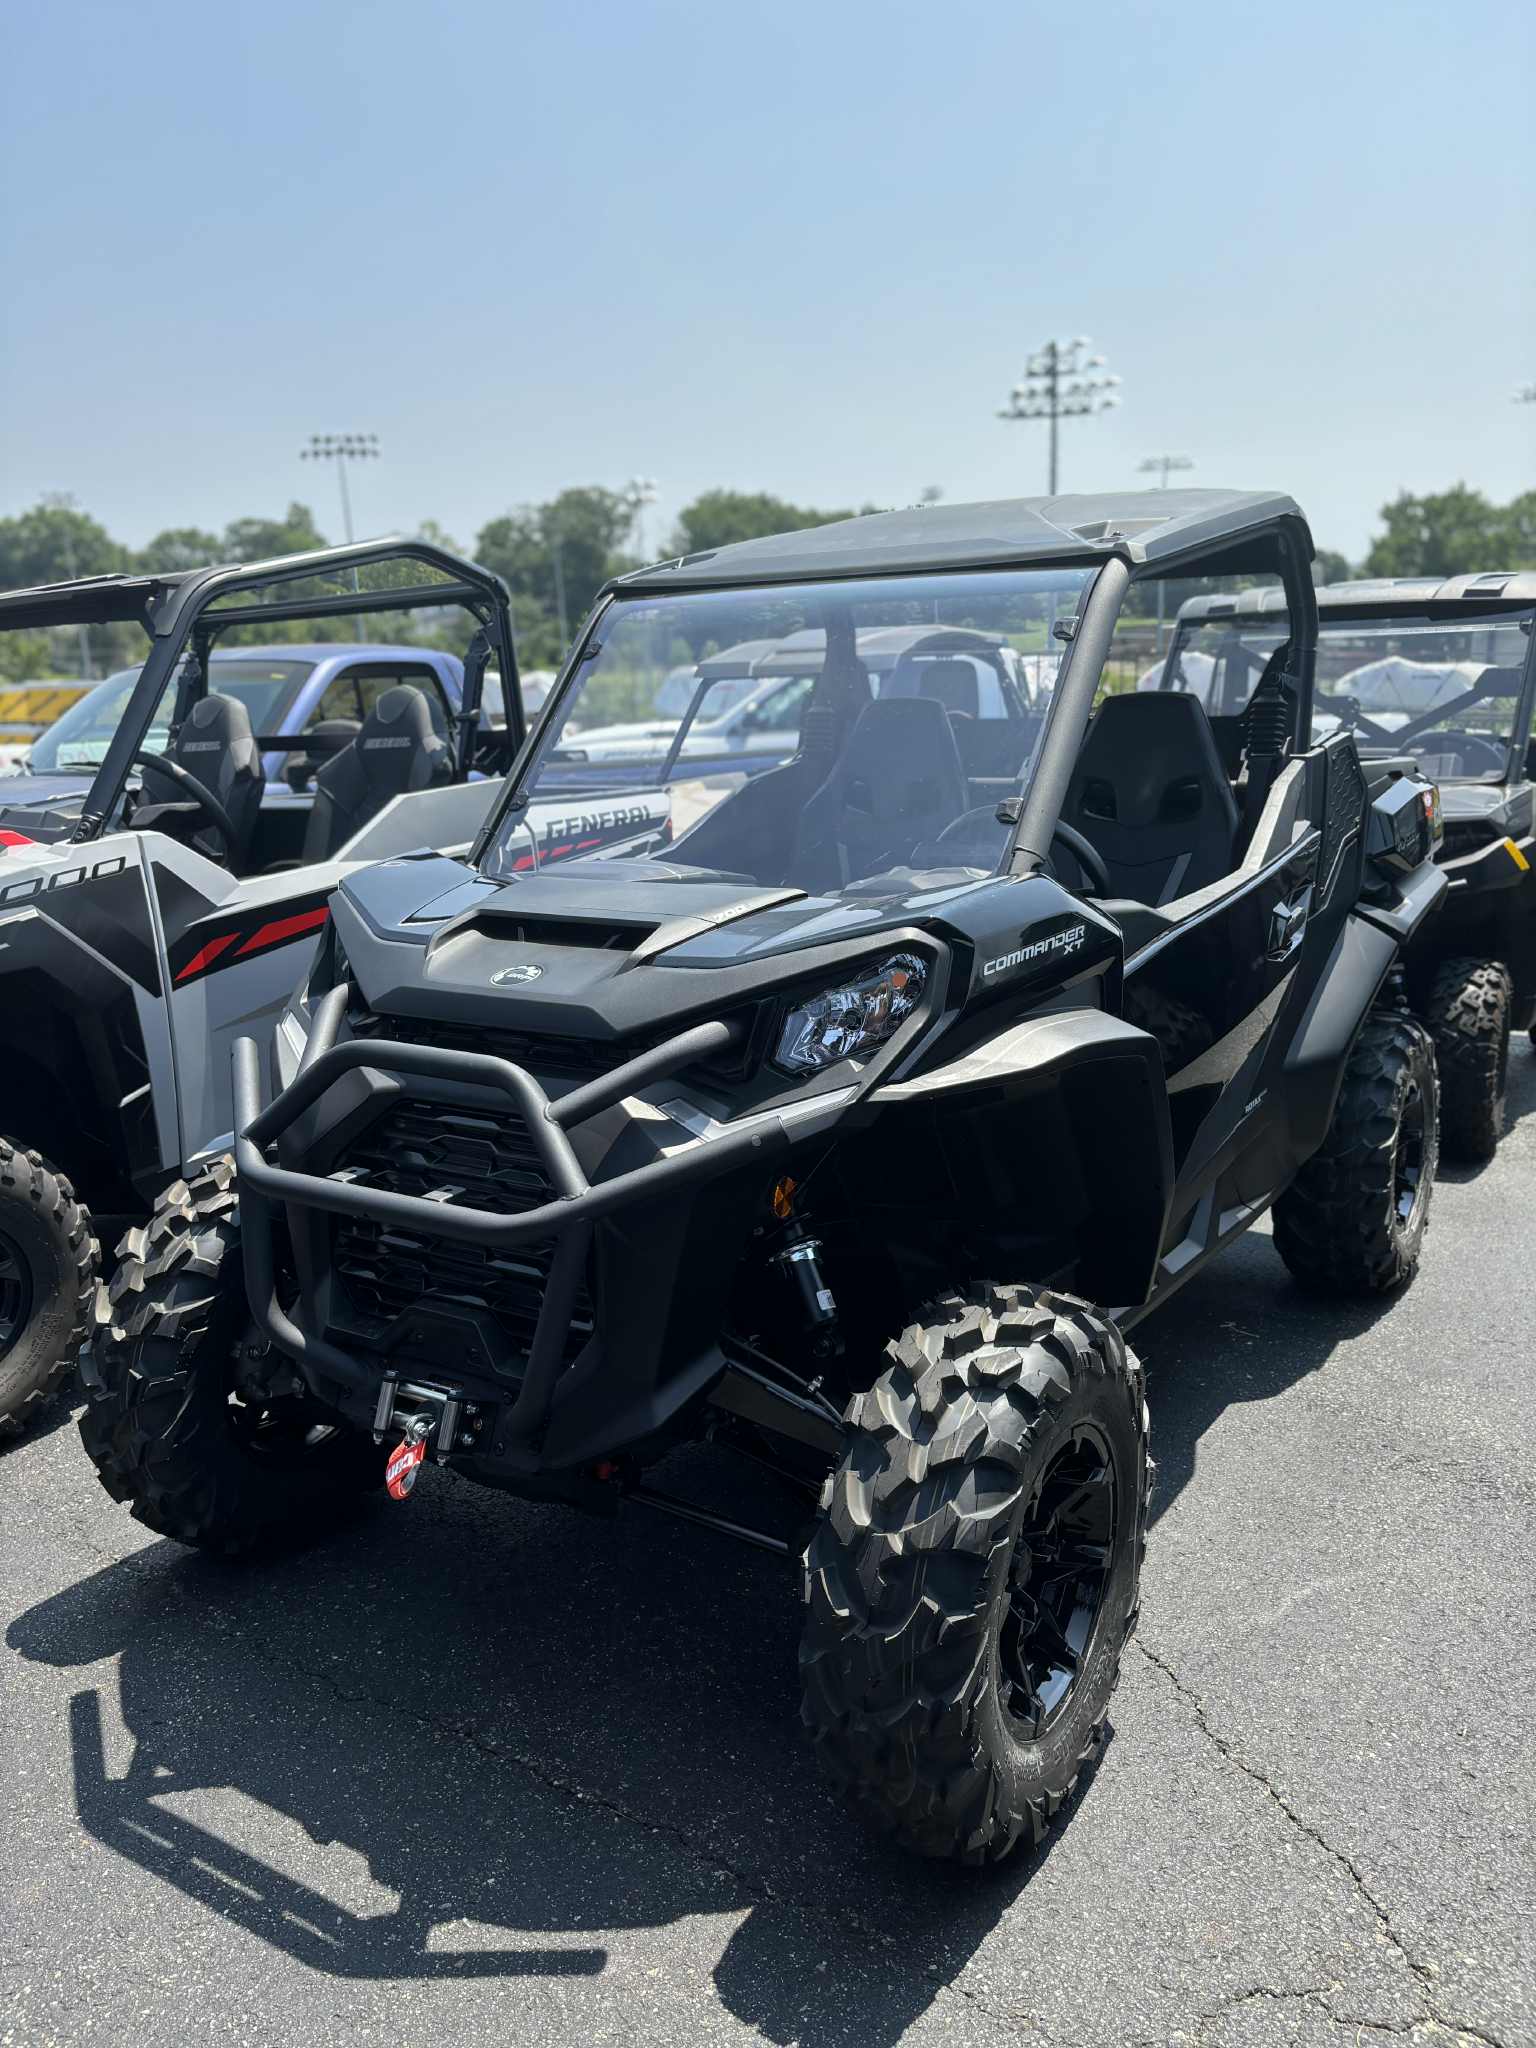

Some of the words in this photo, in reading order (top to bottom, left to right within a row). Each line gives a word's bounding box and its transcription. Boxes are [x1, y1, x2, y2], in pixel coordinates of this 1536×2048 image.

[546, 805, 651, 838] GENERAL
[983, 925, 1085, 976] COMMANDER
[1063, 938, 1085, 956] XT
